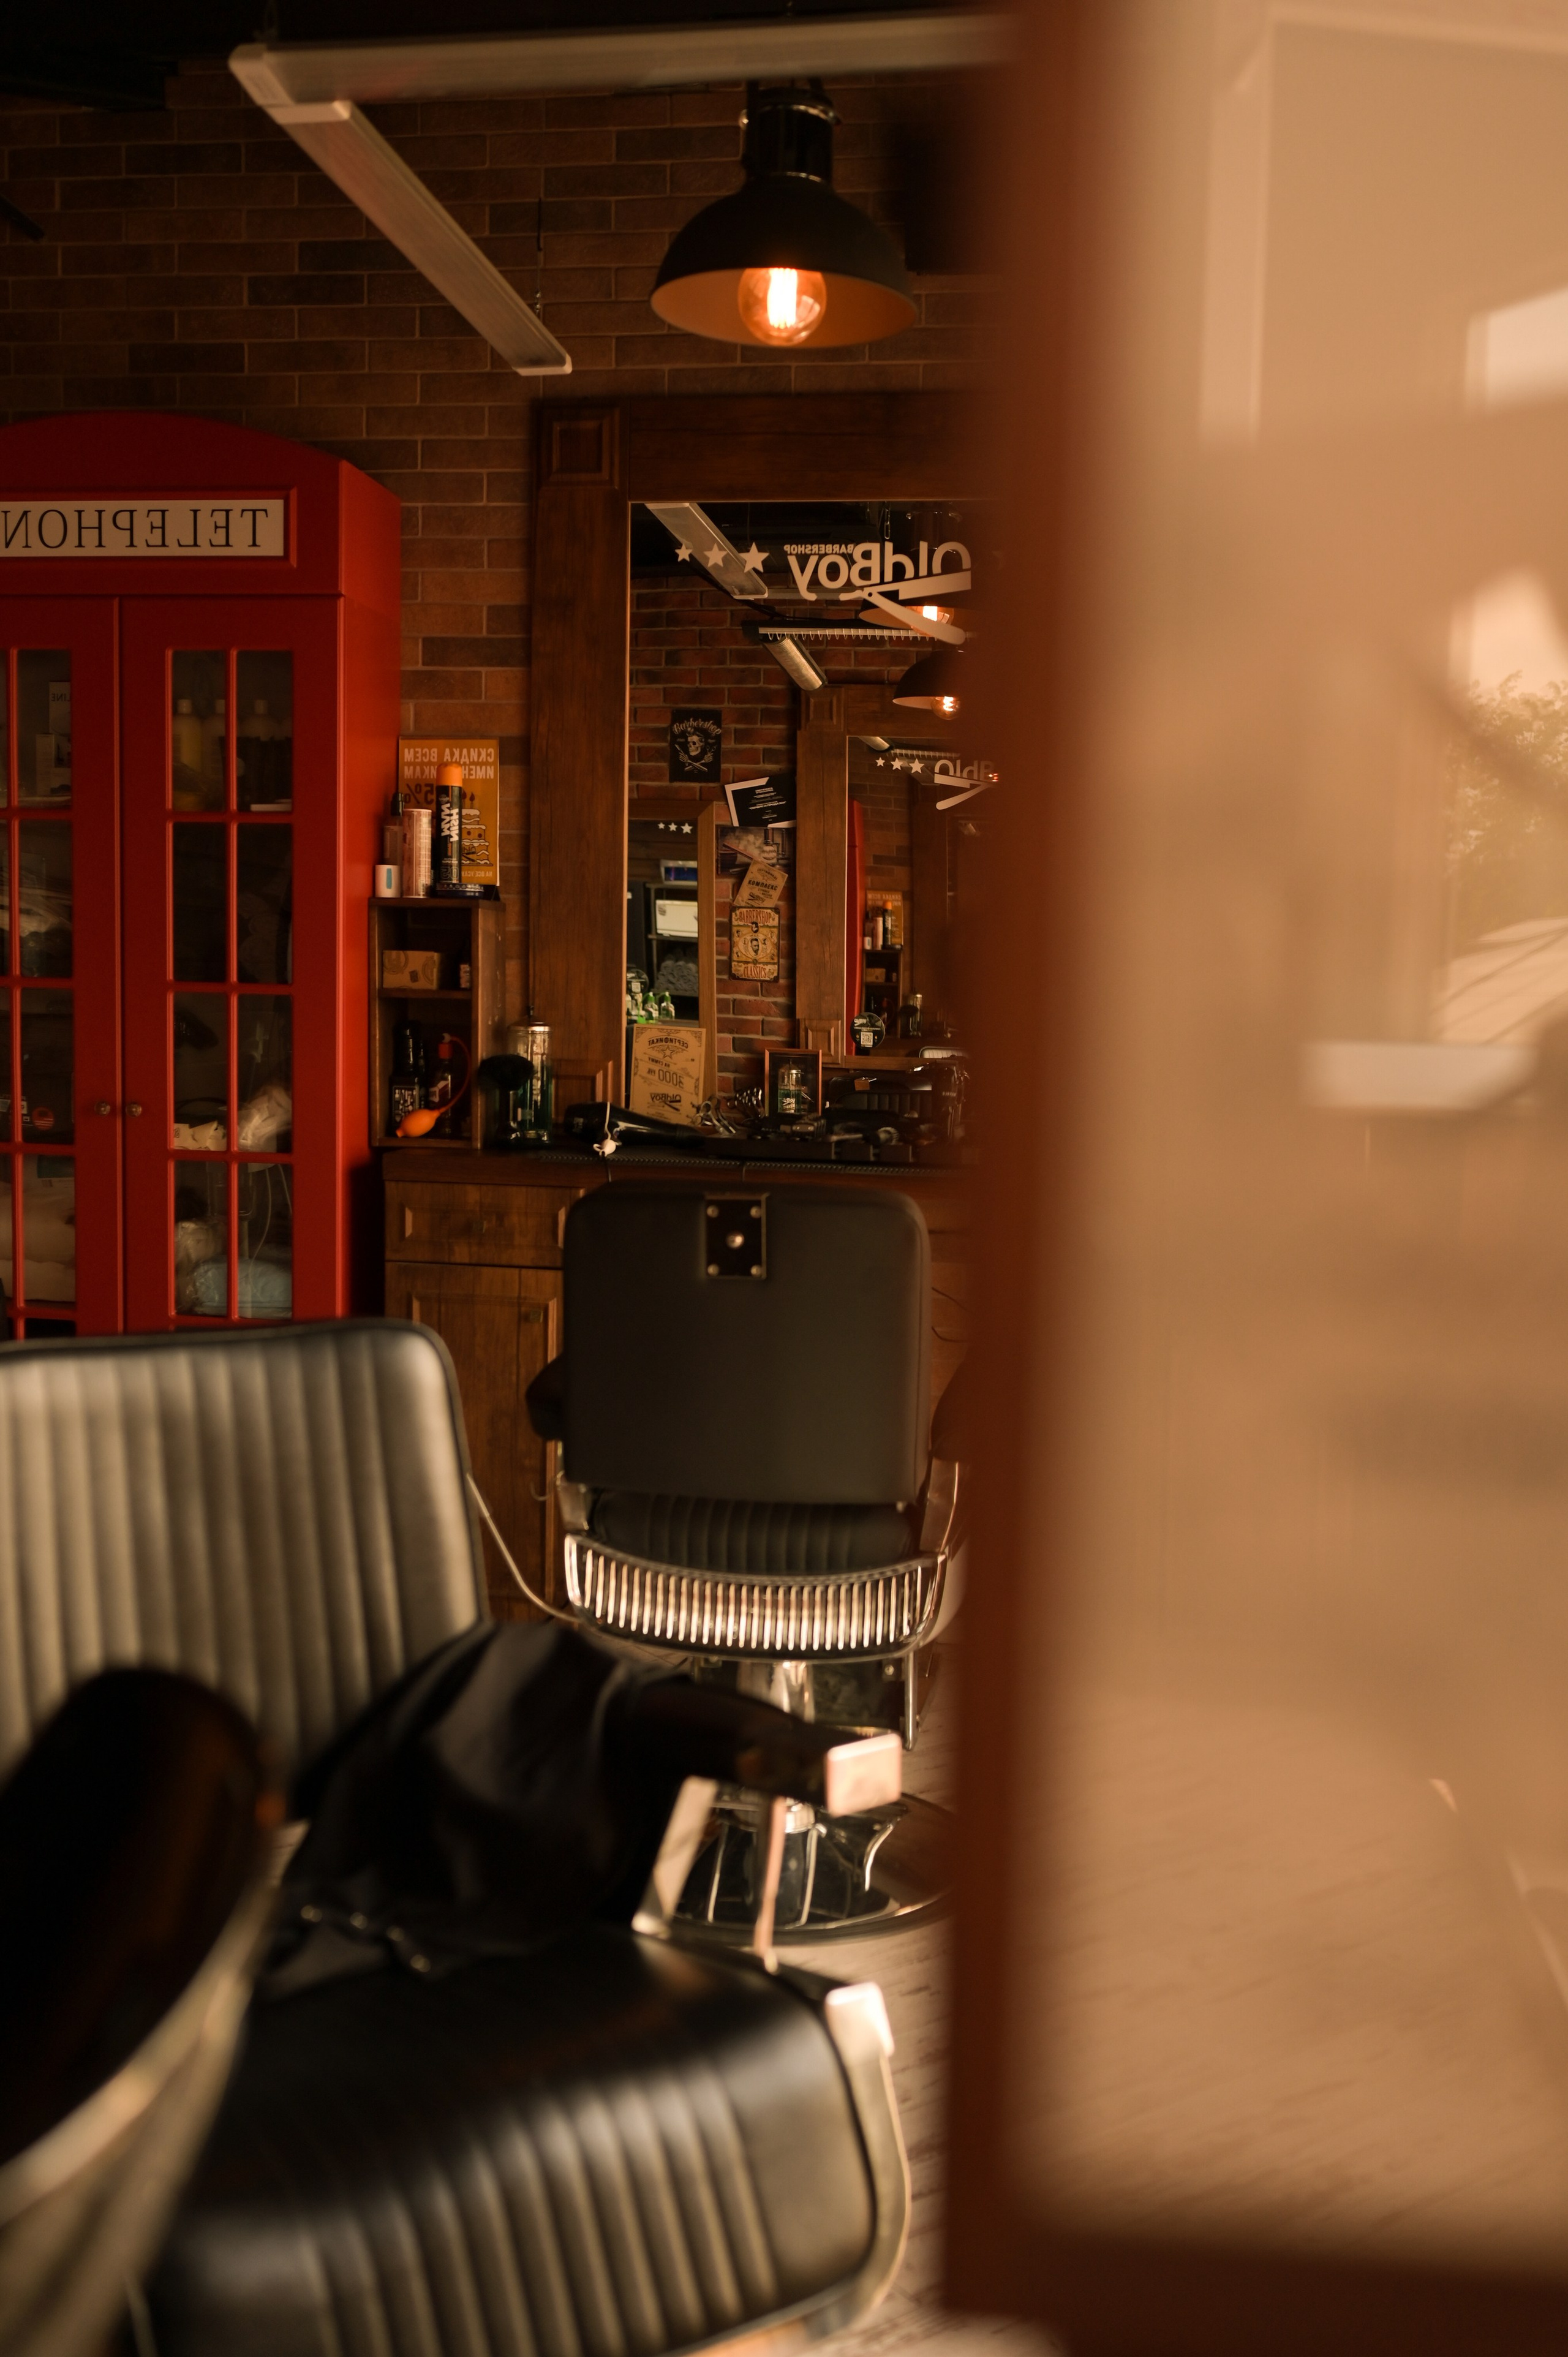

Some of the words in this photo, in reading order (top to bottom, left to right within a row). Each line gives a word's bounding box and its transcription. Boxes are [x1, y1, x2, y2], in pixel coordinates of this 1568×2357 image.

[673, 717, 722, 736] Barbershop
[748, 880, 778, 891] КОМПЛЕКС
[739, 910, 772, 924] BARBERSHOP
[743, 966, 768, 979] CLASSICS
